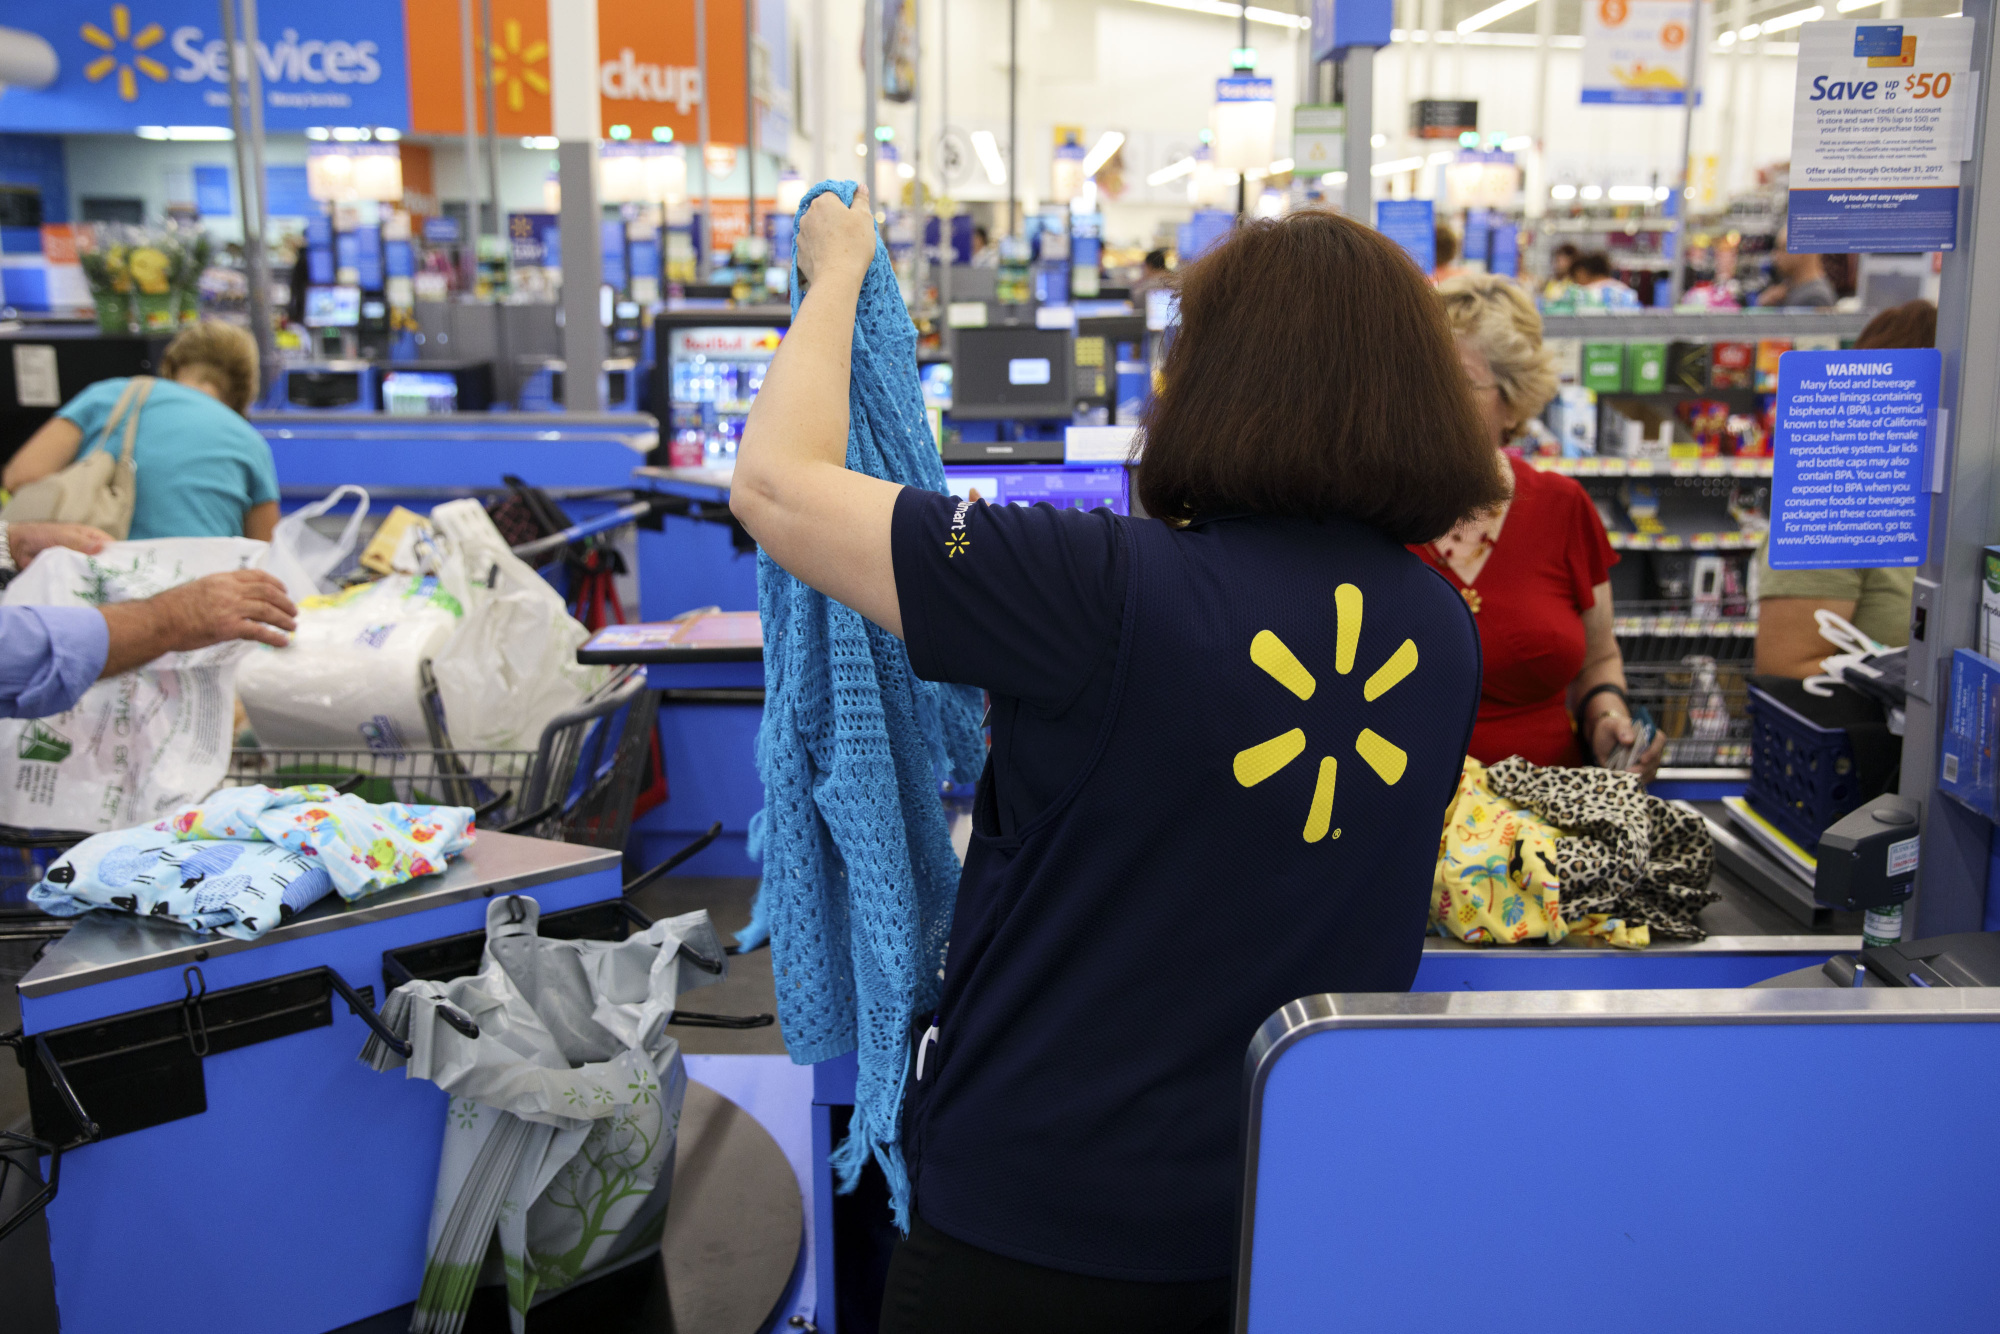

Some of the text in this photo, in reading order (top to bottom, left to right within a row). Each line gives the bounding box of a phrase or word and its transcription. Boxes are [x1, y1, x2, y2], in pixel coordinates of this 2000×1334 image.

[171, 26, 381, 84] Services
[600, 48, 702, 115] ckup
[1809, 72, 1952, 101] Save up to $50
[1816, 107, 1835, 117] Open
[1843, 107, 1872, 115] Walmart
[1896, 106, 1913, 114] Card
[1914, 106, 1942, 114] account
[1892, 116, 1903, 125] (up
[1913, 125, 1935, 133] today.
[1806, 167, 1826, 175] Offer
[1848, 167, 1879, 175] through
[1880, 166, 1911, 174] October
[1925, 165, 1943, 173] 2017.
[1827, 193, 1919, 203] Apply today at any register
[1825, 363, 1893, 376] WARNING
[1800, 378, 1917, 391] Many food and beverage
[1792, 391, 1923, 404] cans have linings containing
[1789, 406, 1836, 418] bisphenol
[1837, 406, 1845, 415] A
[1846, 405, 1873, 416] (BPA),
[1881, 404, 1924, 414] chemical
[1783, 416, 1928, 429] known to the State of California
[1791, 433, 1801, 442] to
[1831, 431, 1857, 441] harm
[1858, 432, 1869, 441] to
[1869, 431, 1886, 440] the
[1886, 430, 1919, 440] female
[1789, 443, 1918, 456] reproductive system. Jar lids
[1796, 456, 1910, 468] and bottle caps may also
[1798, 469, 1907, 481] contain BPA. You can be
[1792, 483, 1911, 495] exposed to BPA when you
[1785, 499, 1828, 507] consume
[1829, 496, 1856, 506] foods
[1868, 496, 1917, 507] beverages
[1782, 508, 1917, 521] packaged in these containers.
[1785, 520, 1913, 533] For more information, go to:
[1777, 532, 1919, 546] www.P65Warnings.ca.gov/BPA.
